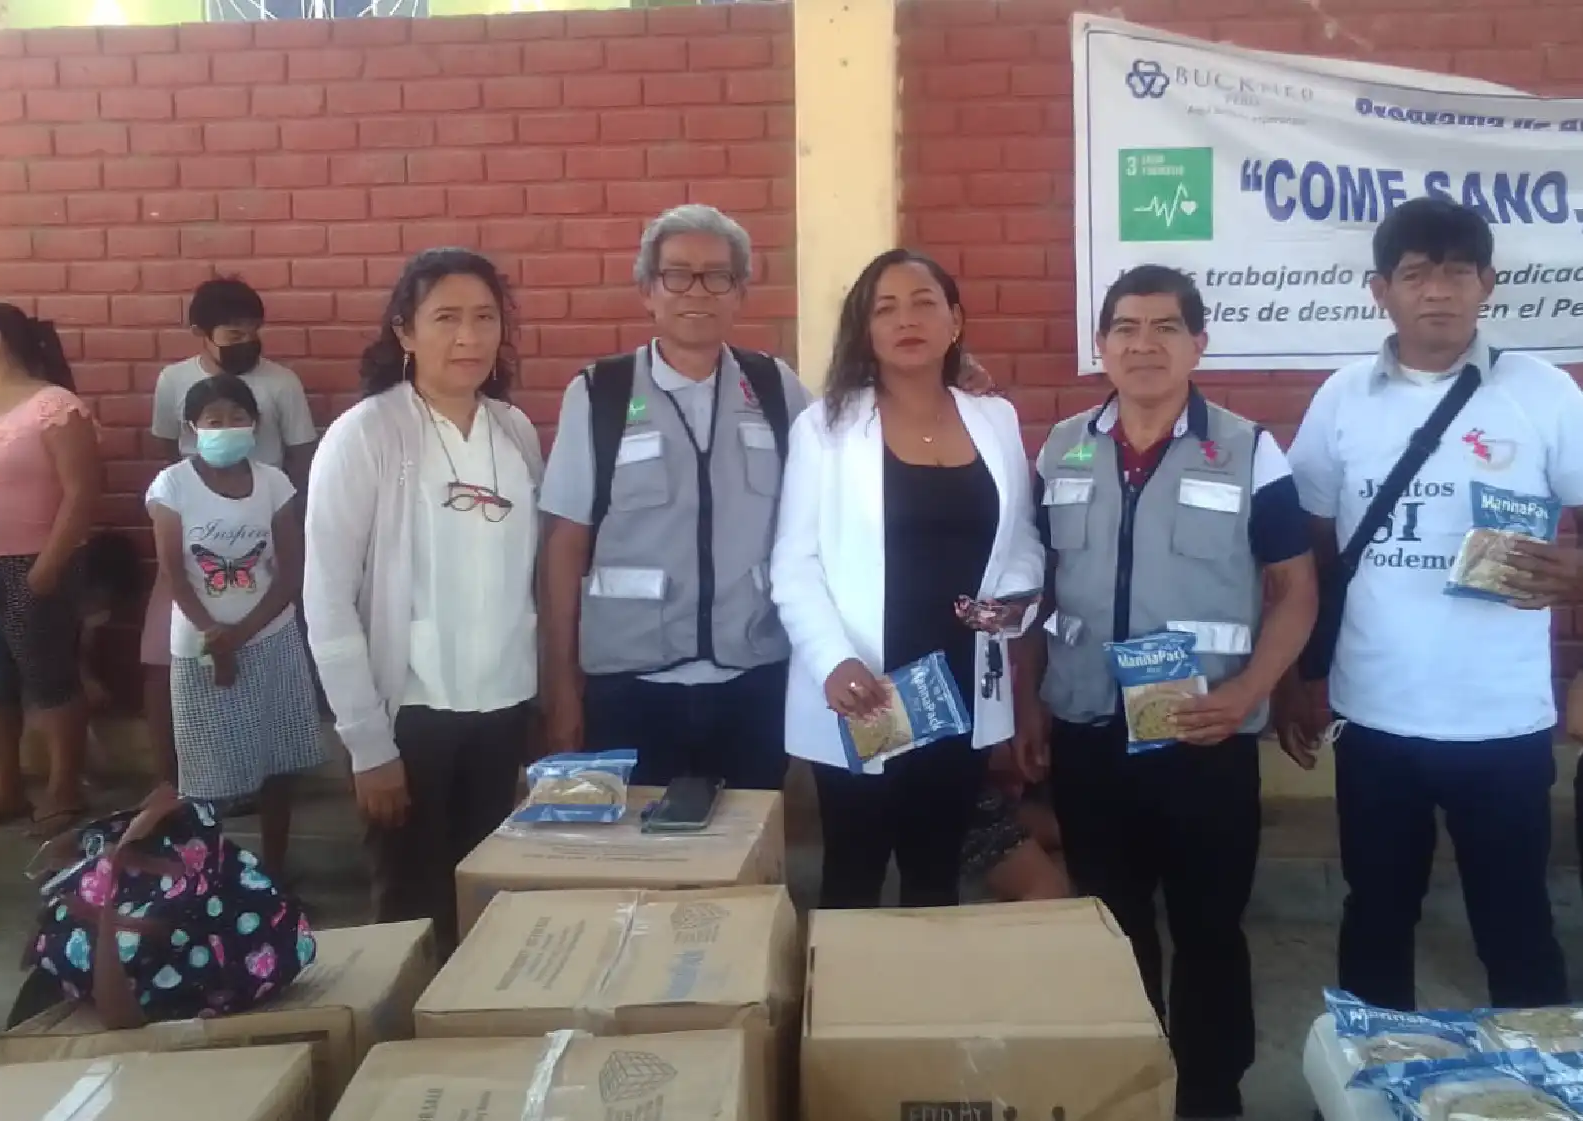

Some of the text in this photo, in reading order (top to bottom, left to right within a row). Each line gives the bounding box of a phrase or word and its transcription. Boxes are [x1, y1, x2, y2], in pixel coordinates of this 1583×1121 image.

[1126, 156, 1137, 176] 3
[1206, 264, 1352, 291] trabajando
[1203, 302, 1248, 323] eles
[1258, 302, 1291, 322] de
[1519, 297, 1546, 318] el
[1358, 478, 1454, 498] Jtos
